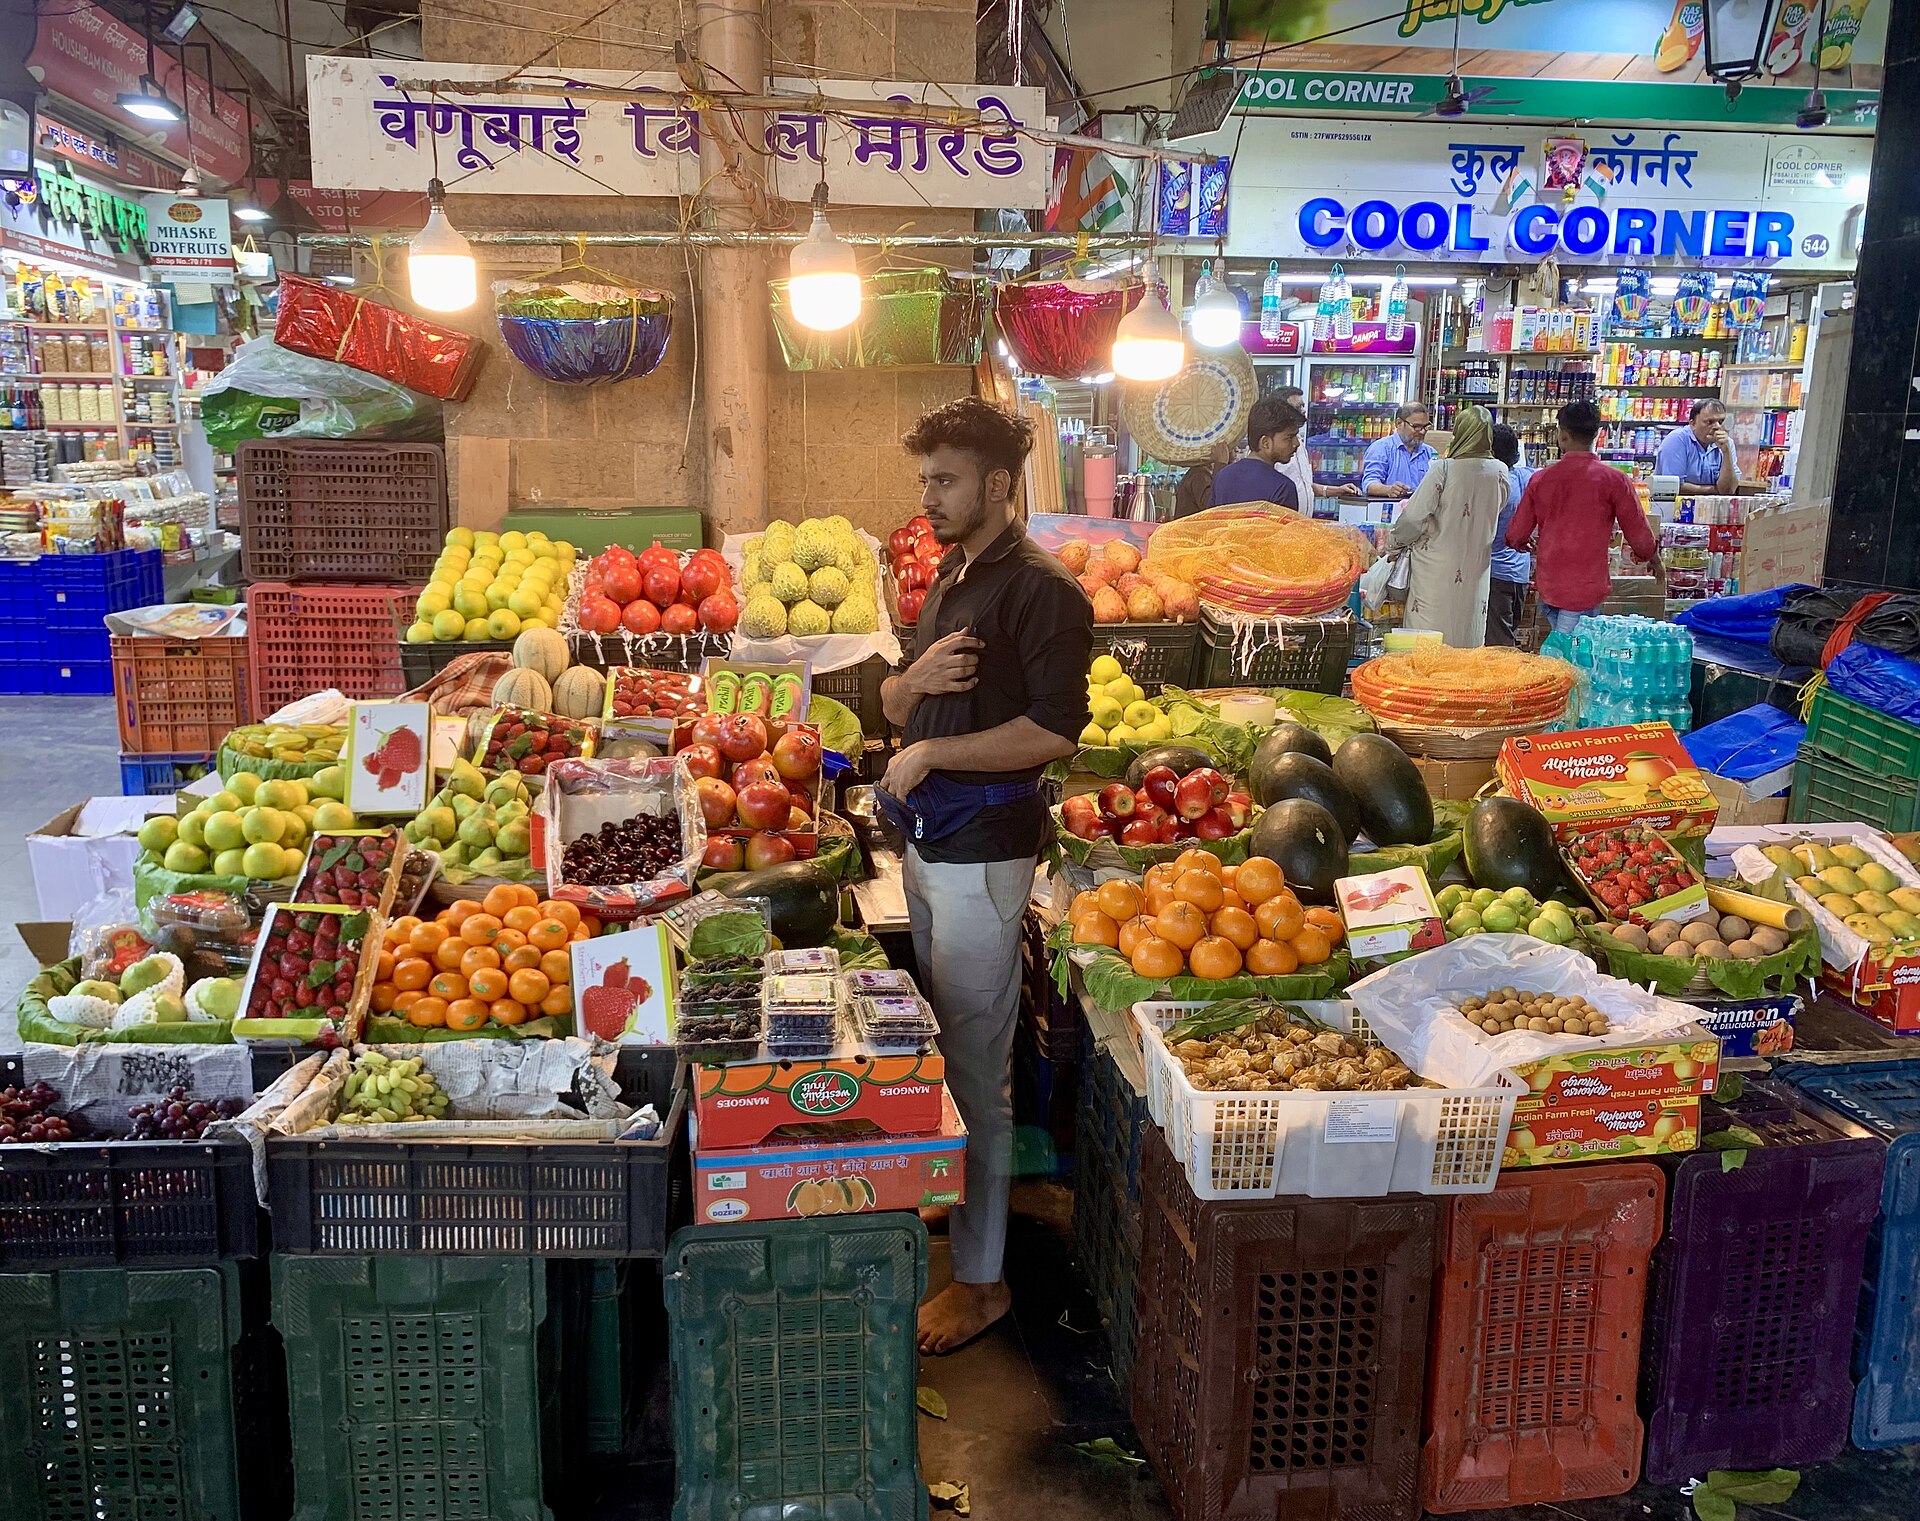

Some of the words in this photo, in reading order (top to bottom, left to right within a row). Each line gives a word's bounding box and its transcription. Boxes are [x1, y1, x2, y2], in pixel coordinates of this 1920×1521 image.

[1683, 6, 1699, 15] RAS
[1787, 6, 1802, 15] RAS
[1824, 18, 1860, 34] Nimbu
[1834, 25, 1859, 37] paani
[51, 28, 101, 72] HOUSHIRAM
[1244, 77, 1298, 100] OOL
[1304, 79, 1414, 104] CORNER
[1291, 131, 1308, 140] GSTIN
[1448, 143, 1525, 198] कुल
[1589, 132, 1698, 189] कॉर्नर
[1776, 161, 1802, 170] COOL
[1804, 162, 1843, 171] CORNER
[317, 205, 362, 218] STORE
[157, 226, 216, 240] MHASKE
[1297, 196, 1491, 252] COOL
[1511, 203, 1795, 258] CORNER
[150, 241, 227, 256] DRYFRUITS
[1803, 239, 1827, 253] 544
[156, 257, 176, 267] Shop
[1351, 331, 1379, 345] CAMPA
[1536, 739, 1583, 752] Indian
[1585, 735, 1623, 748] Farm
[1624, 730, 1665, 743] Fresh
[1541, 753, 1616, 772] Alphonso
[1564, 763, 1628, 779] Mango
[1567, 820, 1590, 828] Indian
[1592, 818, 1610, 826] Farm
[1611, 815, 1633, 824] Fresh
[1720, 1022, 1756, 1030] DELICIOUS
[802, 1081, 827, 1092] fruit
[1561, 1075, 1602, 1089] Mango
[800, 1088, 851, 1103] westfalia
[880, 1085, 930, 1097] MANGOES
[1562, 1084, 1614, 1097] Alphonso
[1610, 1089, 1636, 1099] Fresh
[1638, 1087, 1662, 1097] Farm
[1663, 1085, 1692, 1094] Indian
[717, 1096, 770, 1109] MANGOES
[1822, 1088, 1896, 1130] 2025
[1514, 1113, 1543, 1123] Indian
[1545, 1110, 1569, 1120] Farm
[1571, 1107, 1596, 1118] Fresh
[1594, 1109, 1644, 1124] Alphonso
[1606, 1119, 1646, 1133] Mango
[759, 1165, 793, 1179] खाओ
[796, 1163, 820, 1177] शान
[869, 1157, 894, 1171] शान
[931, 1193, 959, 1202] ORGANIC
[712, 1208, 744, 1217] DOZENS
